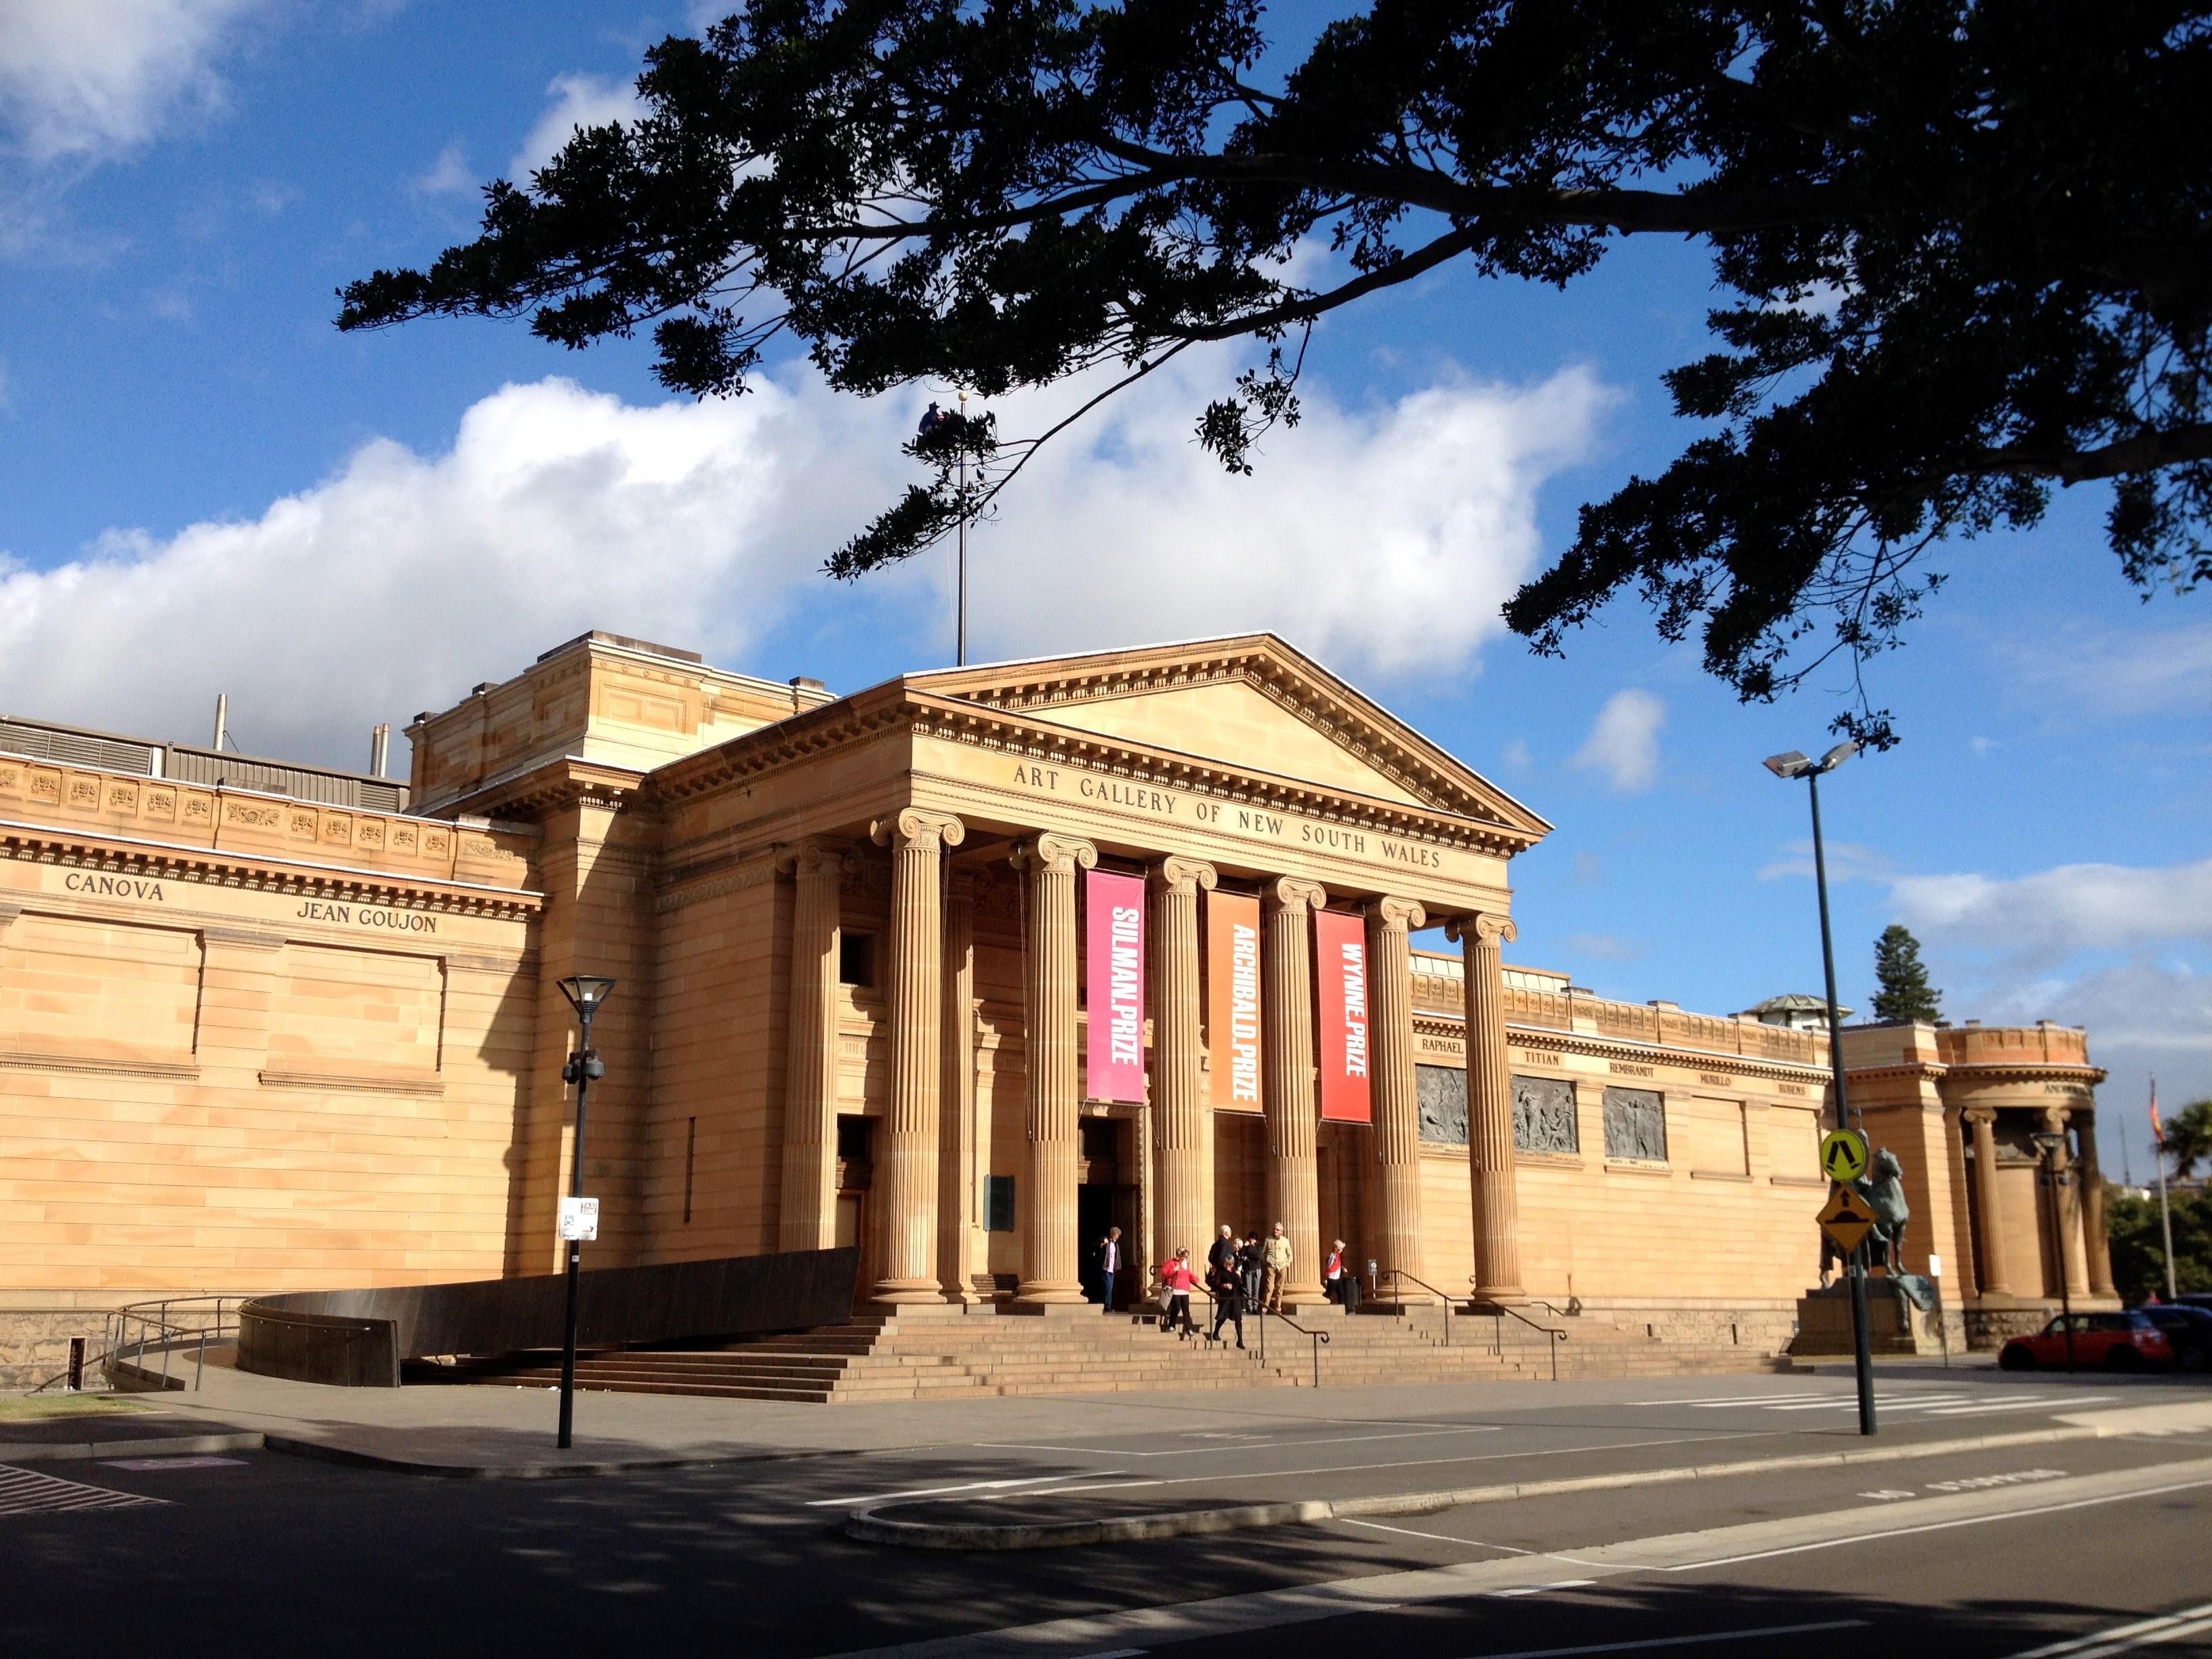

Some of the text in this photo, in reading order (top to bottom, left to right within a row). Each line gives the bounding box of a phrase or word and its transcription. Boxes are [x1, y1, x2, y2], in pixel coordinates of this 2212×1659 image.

[1014, 764, 1439, 868] ART GALLERY OF NEW SOUTH WALES
[66, 873, 163, 901] CANOVA
[297, 902, 437, 933] JEAN GOUJON
[1422, 1038, 1464, 1054] RAPHAEL
[1524, 1052, 1559, 1066] TITIAN
[1609, 1062, 1654, 1078] REMBRANDT
[1700, 1073, 1732, 1087] MURILLO
[1778, 1084, 1806, 1097] RUBENS
